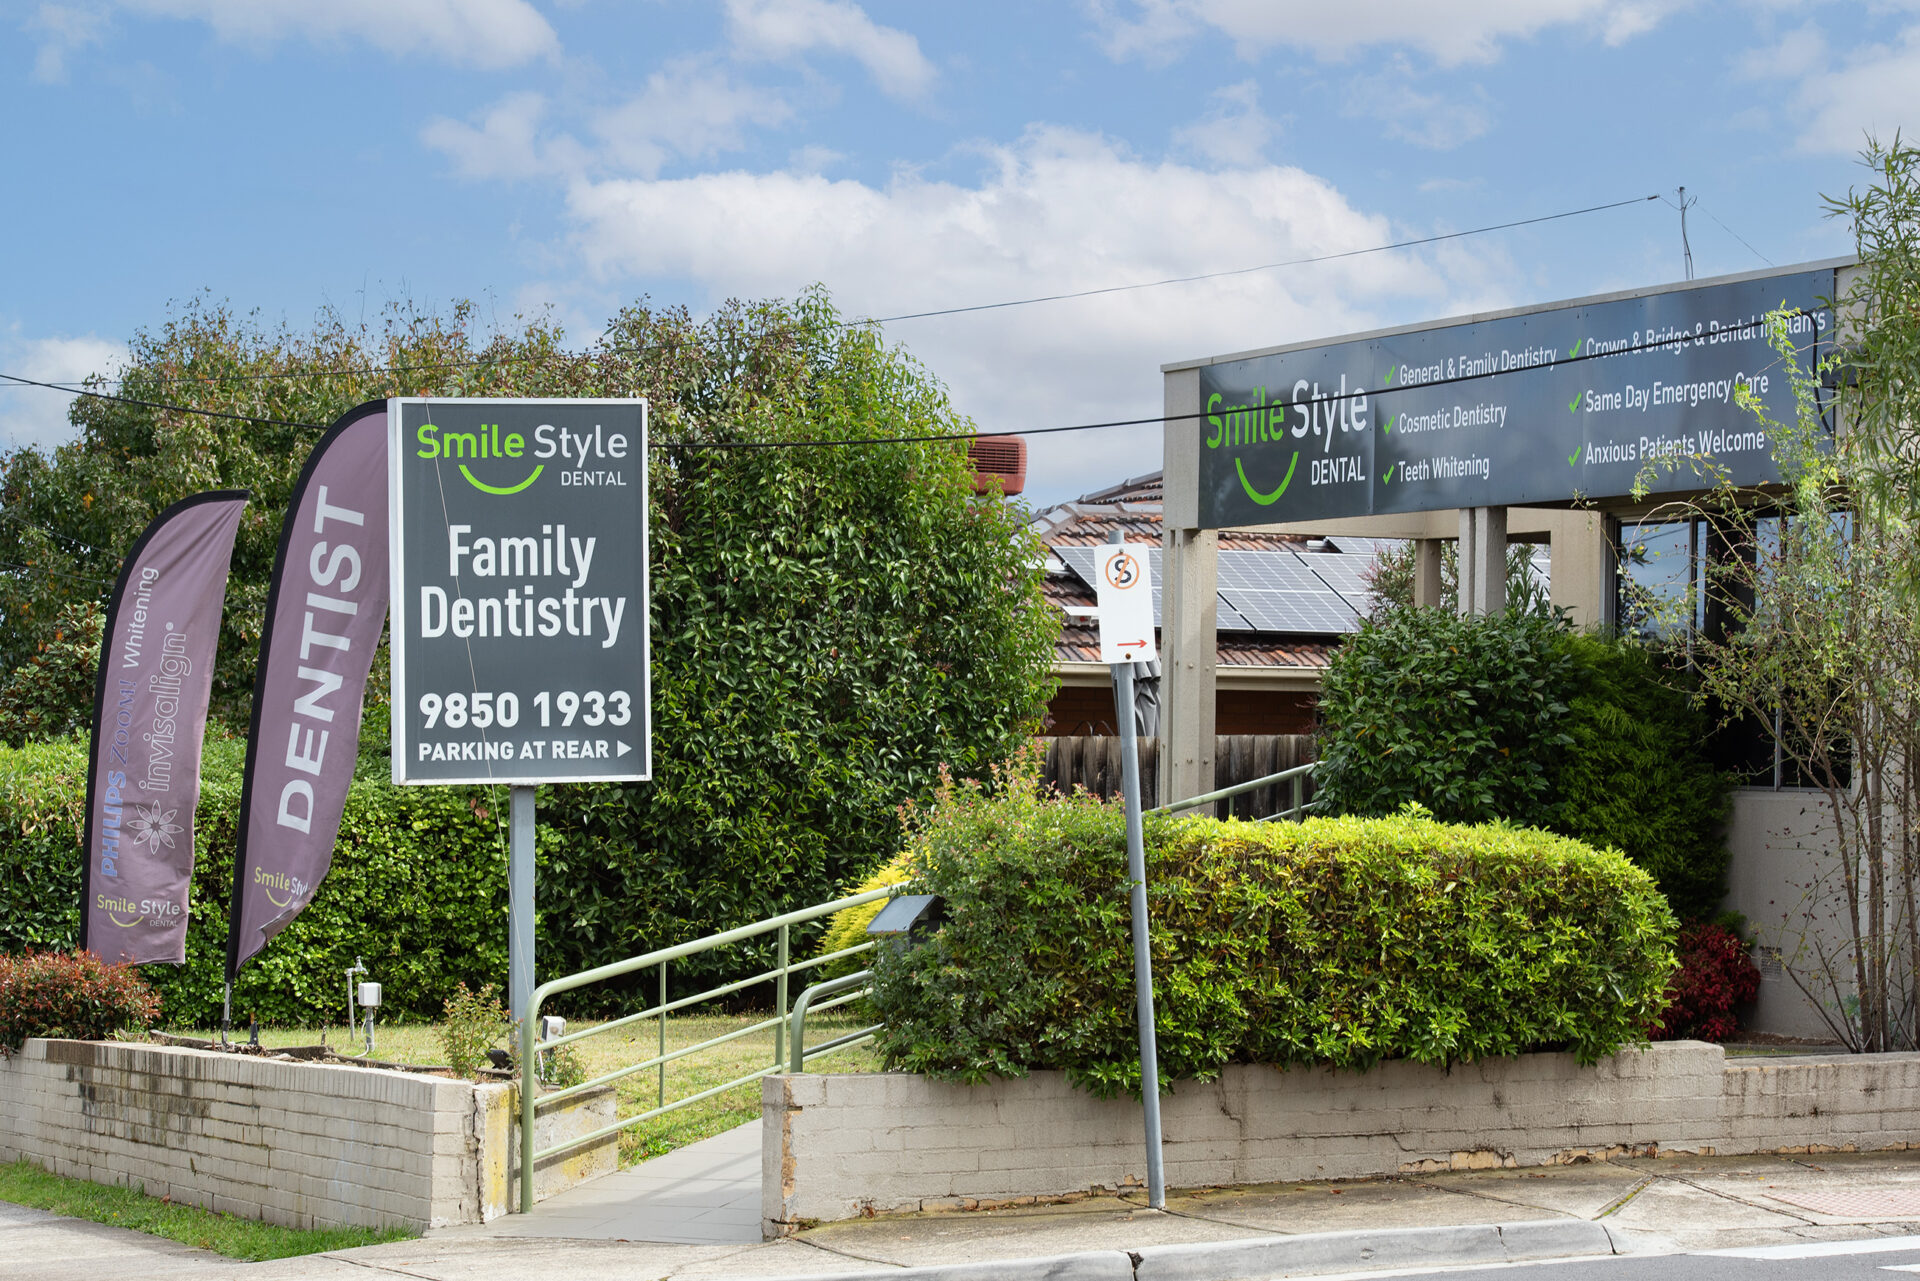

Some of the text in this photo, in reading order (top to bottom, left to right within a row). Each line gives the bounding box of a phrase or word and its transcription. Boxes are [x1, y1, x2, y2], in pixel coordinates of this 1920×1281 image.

[1586, 311, 1826, 361] Crown & Bridge & Dental Ilans
[1400, 346, 1557, 386] General & Family Dentistry
[1206, 373, 1368, 453] Smile Style
[1585, 389, 1621, 413] Same
[1625, 384, 1650, 412] Day
[1653, 379, 1731, 408] Emergency
[1399, 403, 1507, 434] Cosmetic Dentistry
[416, 424, 628, 468] Smile Style
[1585, 429, 1765, 465] Anxious Patients Welcome
[561, 471, 627, 486] DENTAL
[1311, 456, 1365, 486] DENTAL
[1398, 454, 1490, 483] Teeth Whitening
[450, 524, 597, 588] Family
[421, 585, 627, 649] Dentistry
[276, 485, 364, 835] DENTIST
[101, 567, 159, 877] PHILIPS ZOOM! Whitening
[419, 690, 632, 729] 9850 1933
[418, 739, 609, 761] PARKING AT REAR
[254, 866, 290, 891] Smile
[97, 894, 181, 919] Smile Style
[149, 919, 178, 928] DENTAL
